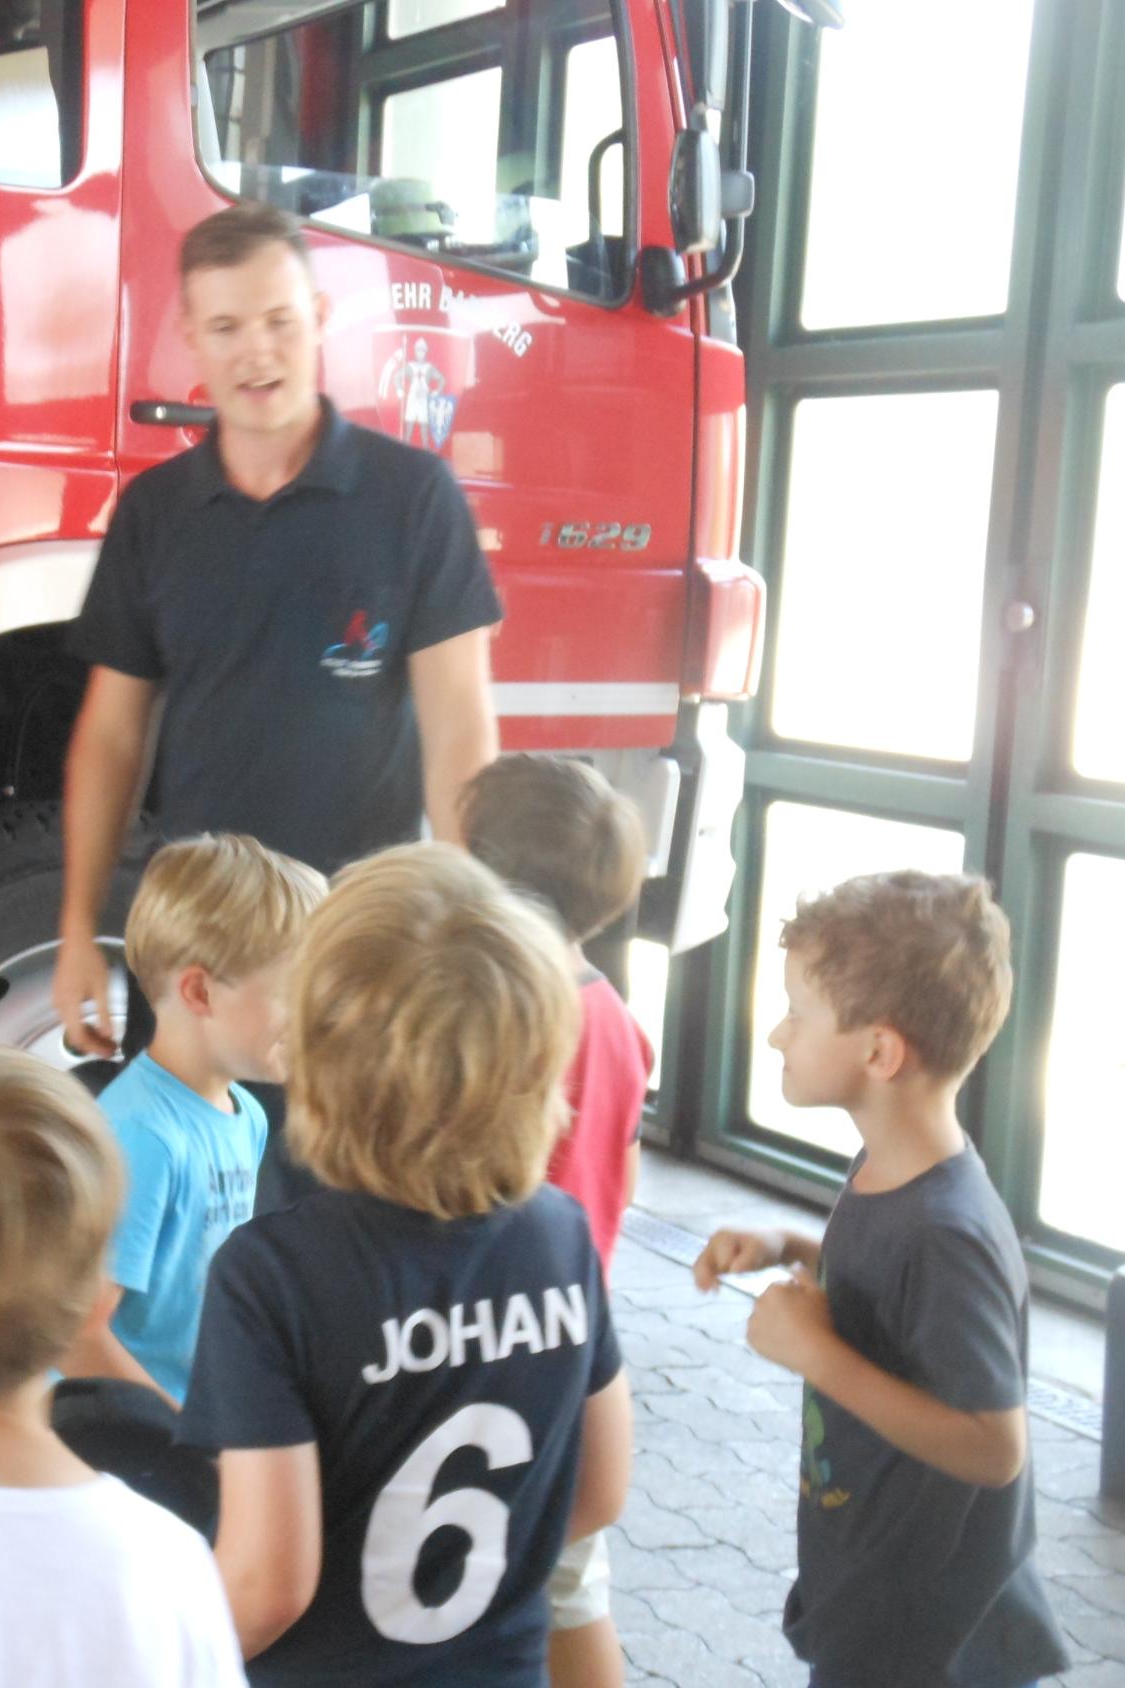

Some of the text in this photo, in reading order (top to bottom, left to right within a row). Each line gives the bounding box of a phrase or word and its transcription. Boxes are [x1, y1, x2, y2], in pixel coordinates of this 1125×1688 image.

[391, 281, 433, 311] EHR
[539, 521, 651, 551] 1629
[362, 1284, 589, 1385] JOHAN
[361, 1402, 534, 1645] 6
